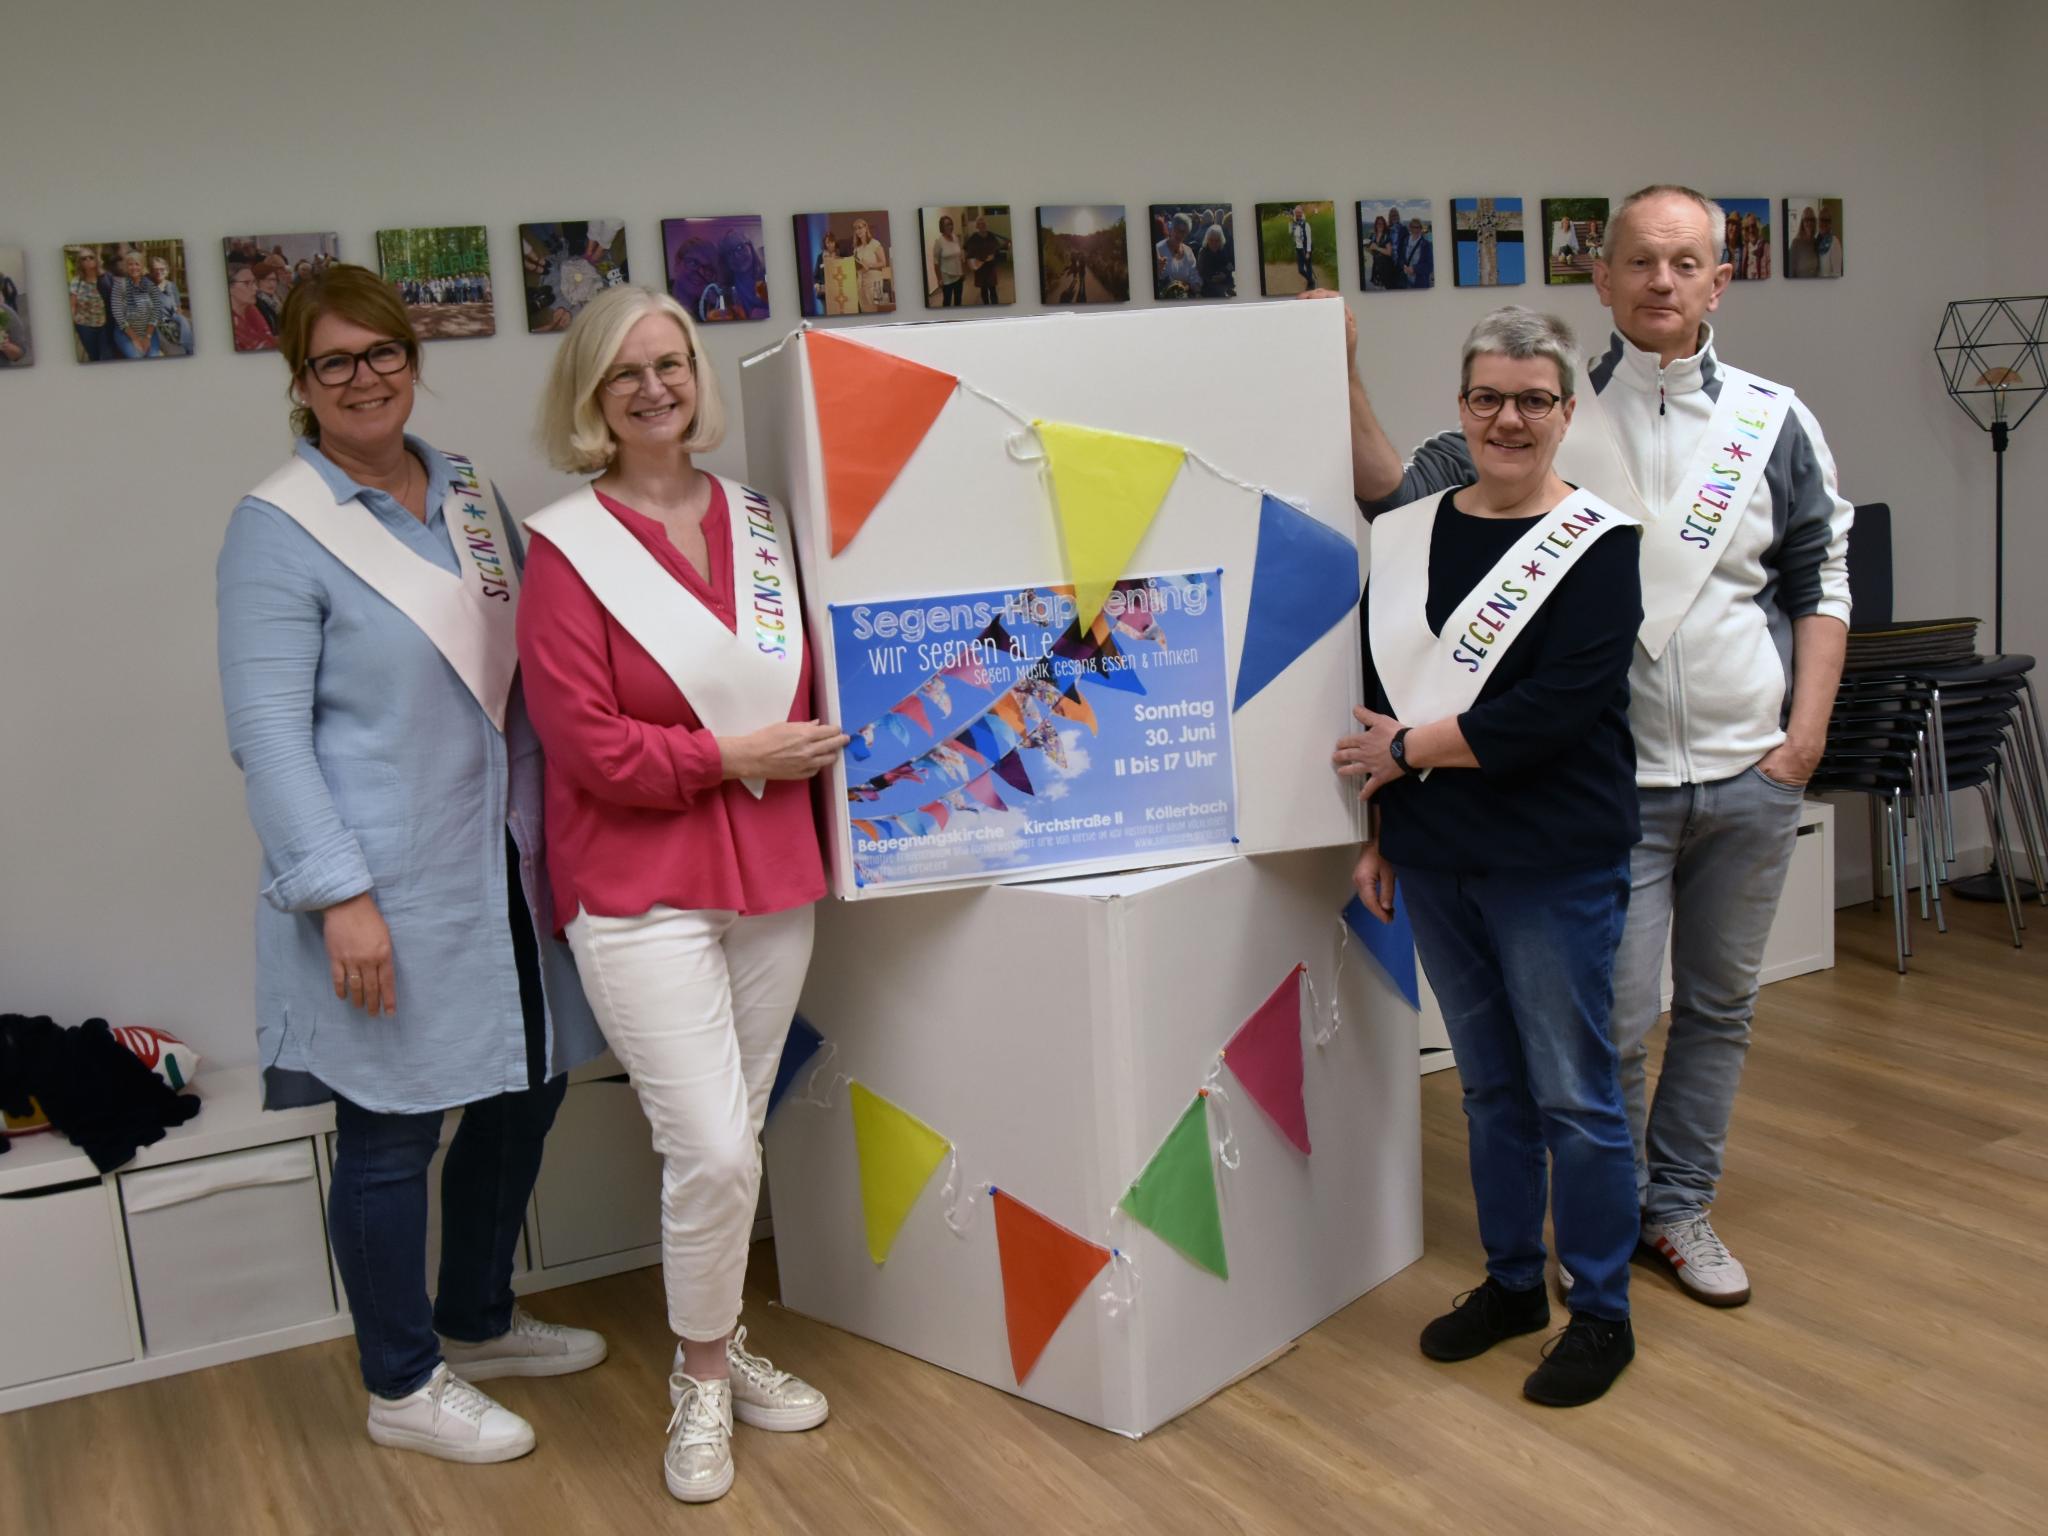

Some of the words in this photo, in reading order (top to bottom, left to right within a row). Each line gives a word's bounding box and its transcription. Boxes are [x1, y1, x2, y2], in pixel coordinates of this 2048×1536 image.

[440, 451, 482, 498] TEAM
[741, 486, 776, 543] TEAM
[1680, 463, 1741, 550] SEGENS
[463, 524, 510, 602] SEGENS
[852, 578, 1207, 643] Segens-Hapening
[1453, 580, 1528, 673] SEGENS
[1534, 507, 1606, 559] TEAM
[753, 570, 786, 660] SEGENS
[919, 637, 999, 672] segnen
[1142, 654, 1149, 669] &
[1134, 699, 1214, 722] Sonntag
[1145, 728, 1173, 746] 30.
[1179, 722, 1216, 743] Juni
[1131, 756, 1159, 774] bis
[1164, 752, 1180, 770] 17
[1184, 750, 1217, 768] Uhr
[858, 825, 1005, 853] Begegnungskirche
[1024, 813, 1111, 834] Kirchstraße
